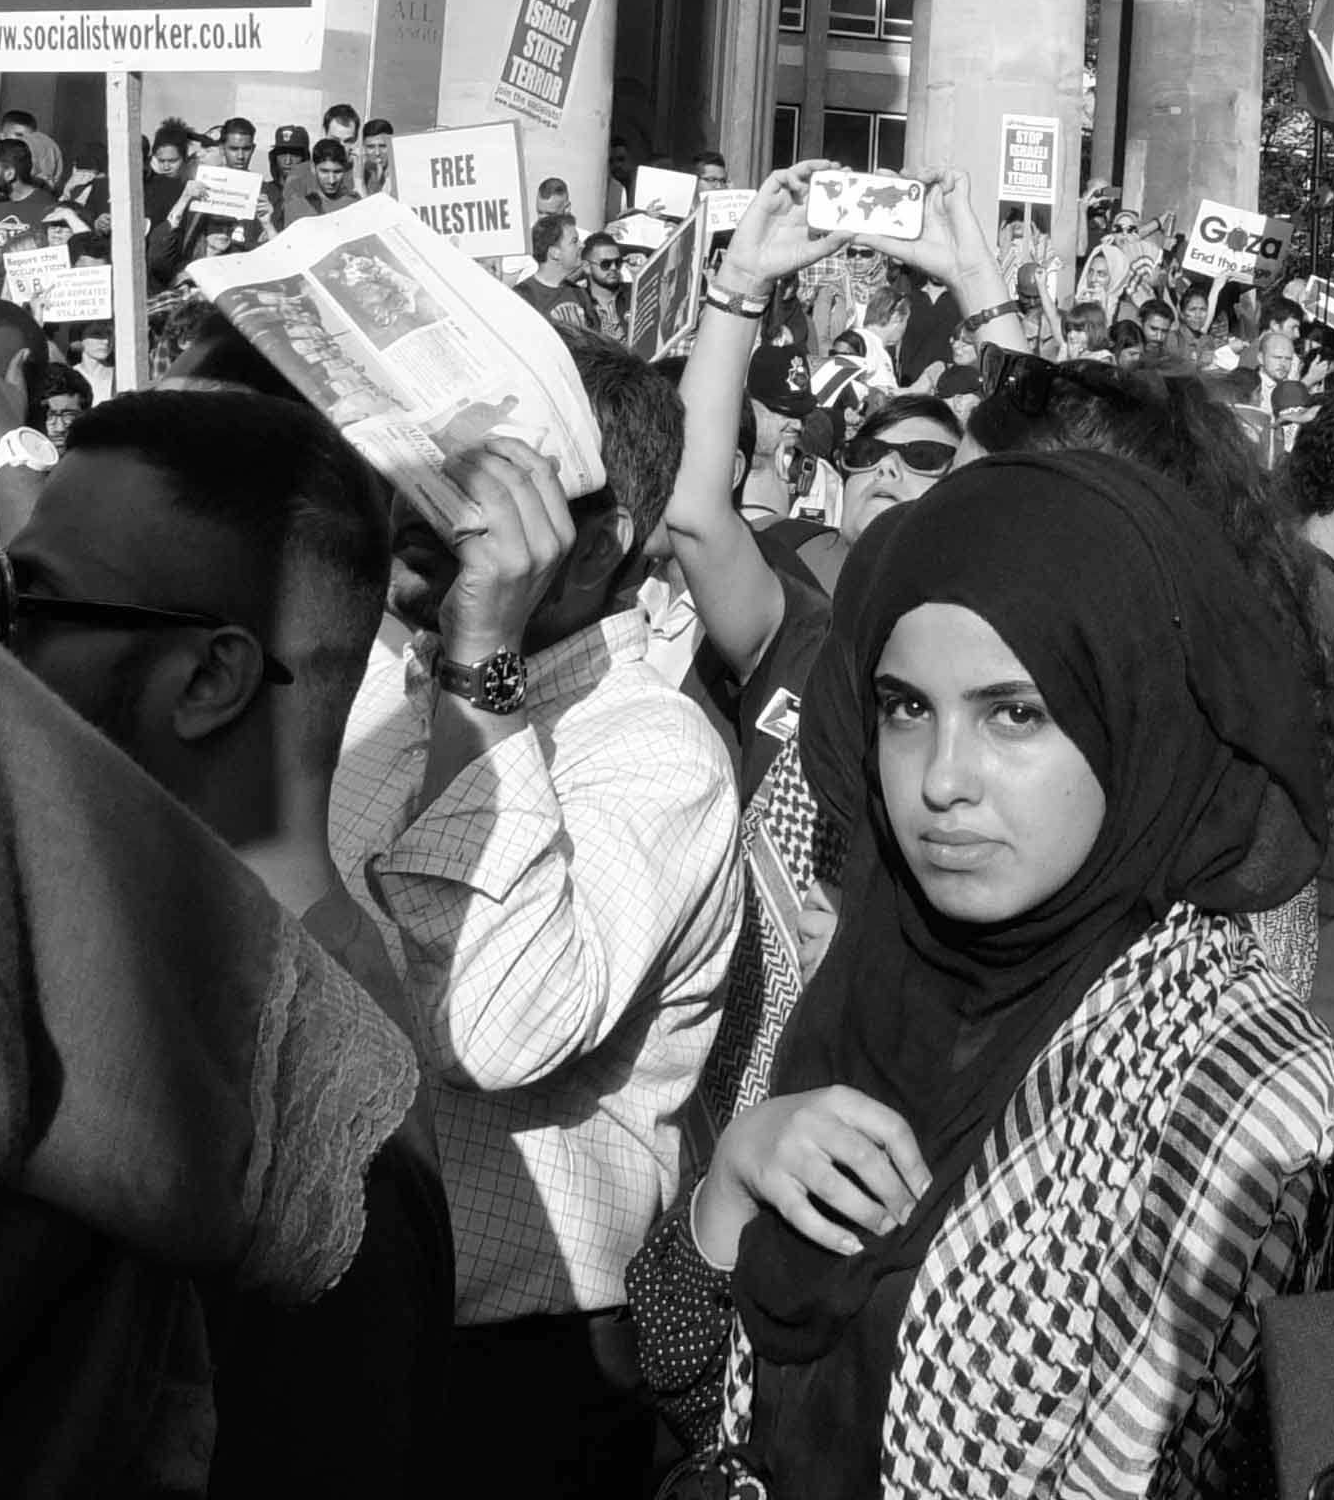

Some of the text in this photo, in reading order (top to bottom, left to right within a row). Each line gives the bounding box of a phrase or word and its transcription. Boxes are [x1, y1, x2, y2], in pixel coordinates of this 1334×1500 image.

[522, 29, 565, 73] STATE
[508, 55, 563, 105] TERROR
[430, 153, 477, 189] FREE
[411, 198, 511, 236] ALESTINE
[1190, 248, 1215, 264] End
[1218, 256, 1237, 271] the
